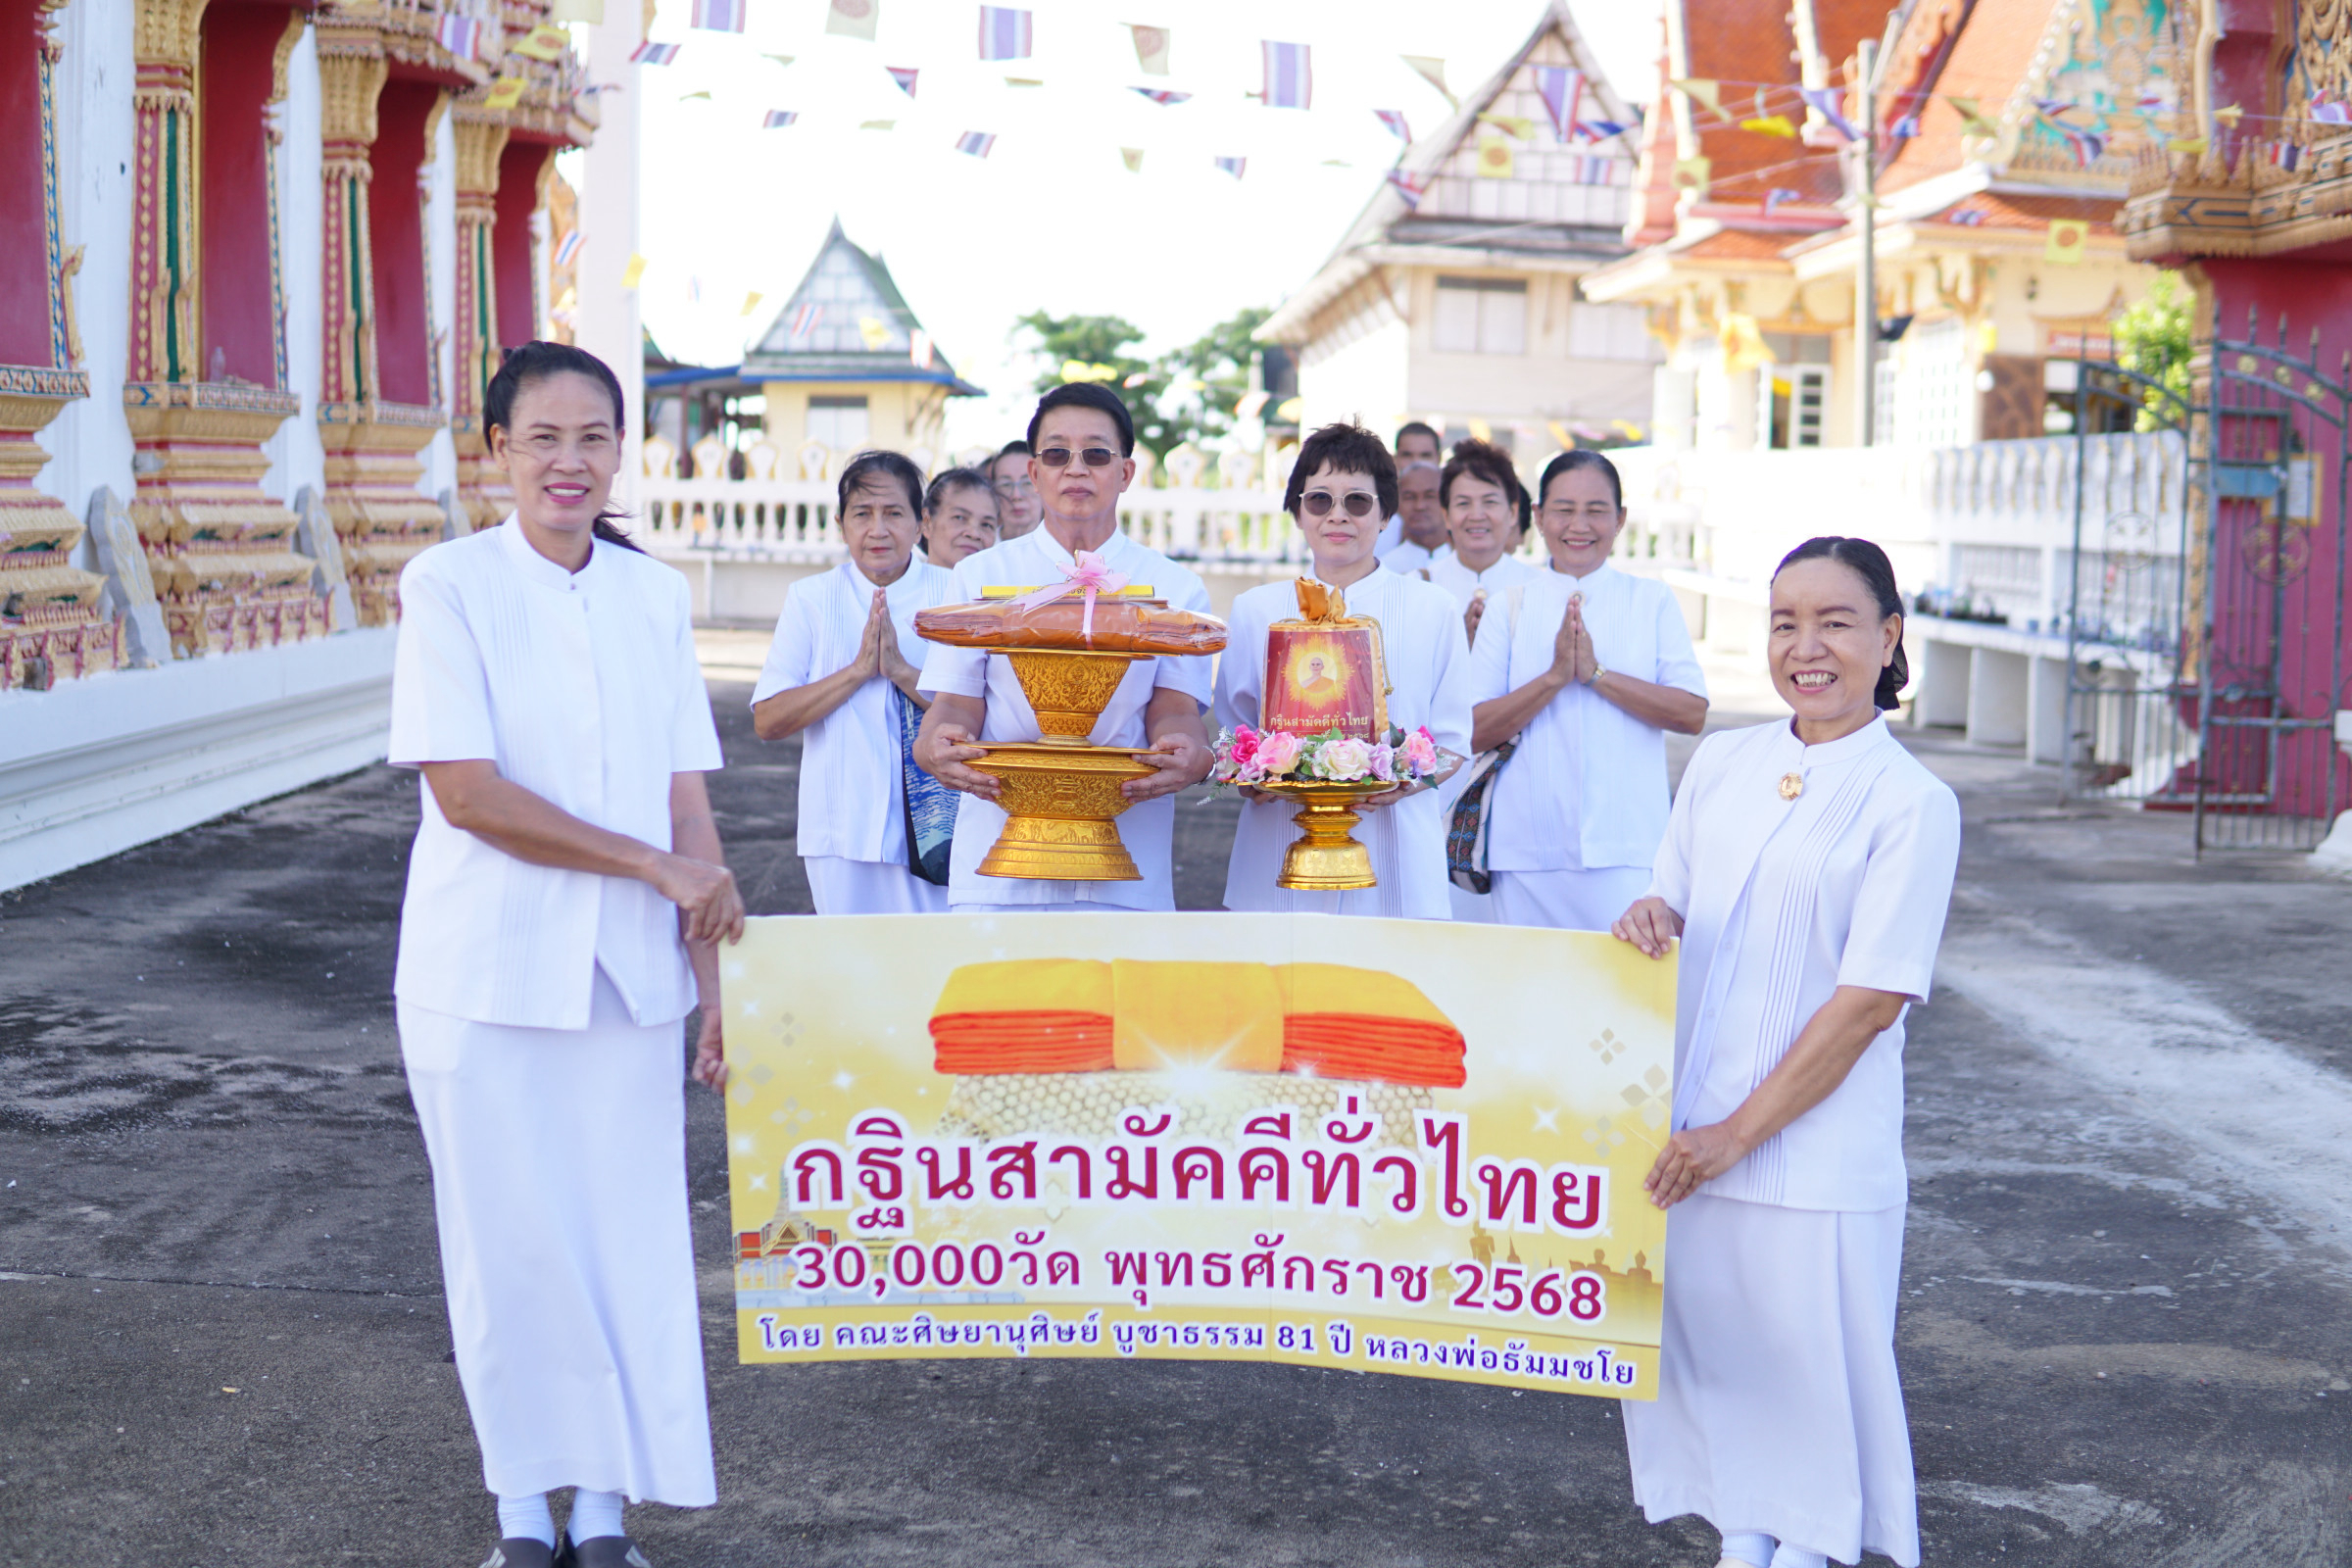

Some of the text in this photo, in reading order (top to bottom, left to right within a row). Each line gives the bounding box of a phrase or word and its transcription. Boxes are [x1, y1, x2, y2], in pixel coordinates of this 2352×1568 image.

[1270, 710, 1368, 730] กฐินสามัคคีทั่วไทย
[793, 1096, 1601, 1230] กฐินสามัคคีทั่วไทย
[795, 1230, 1602, 1321] 30,000วัด พุทธศักราช 2568
[760, 1312, 1634, 1385] โดย คณะศิษยานุศิษย์ บูชาธรรม 81 ปี หลวงพ่อธัมมชโย
